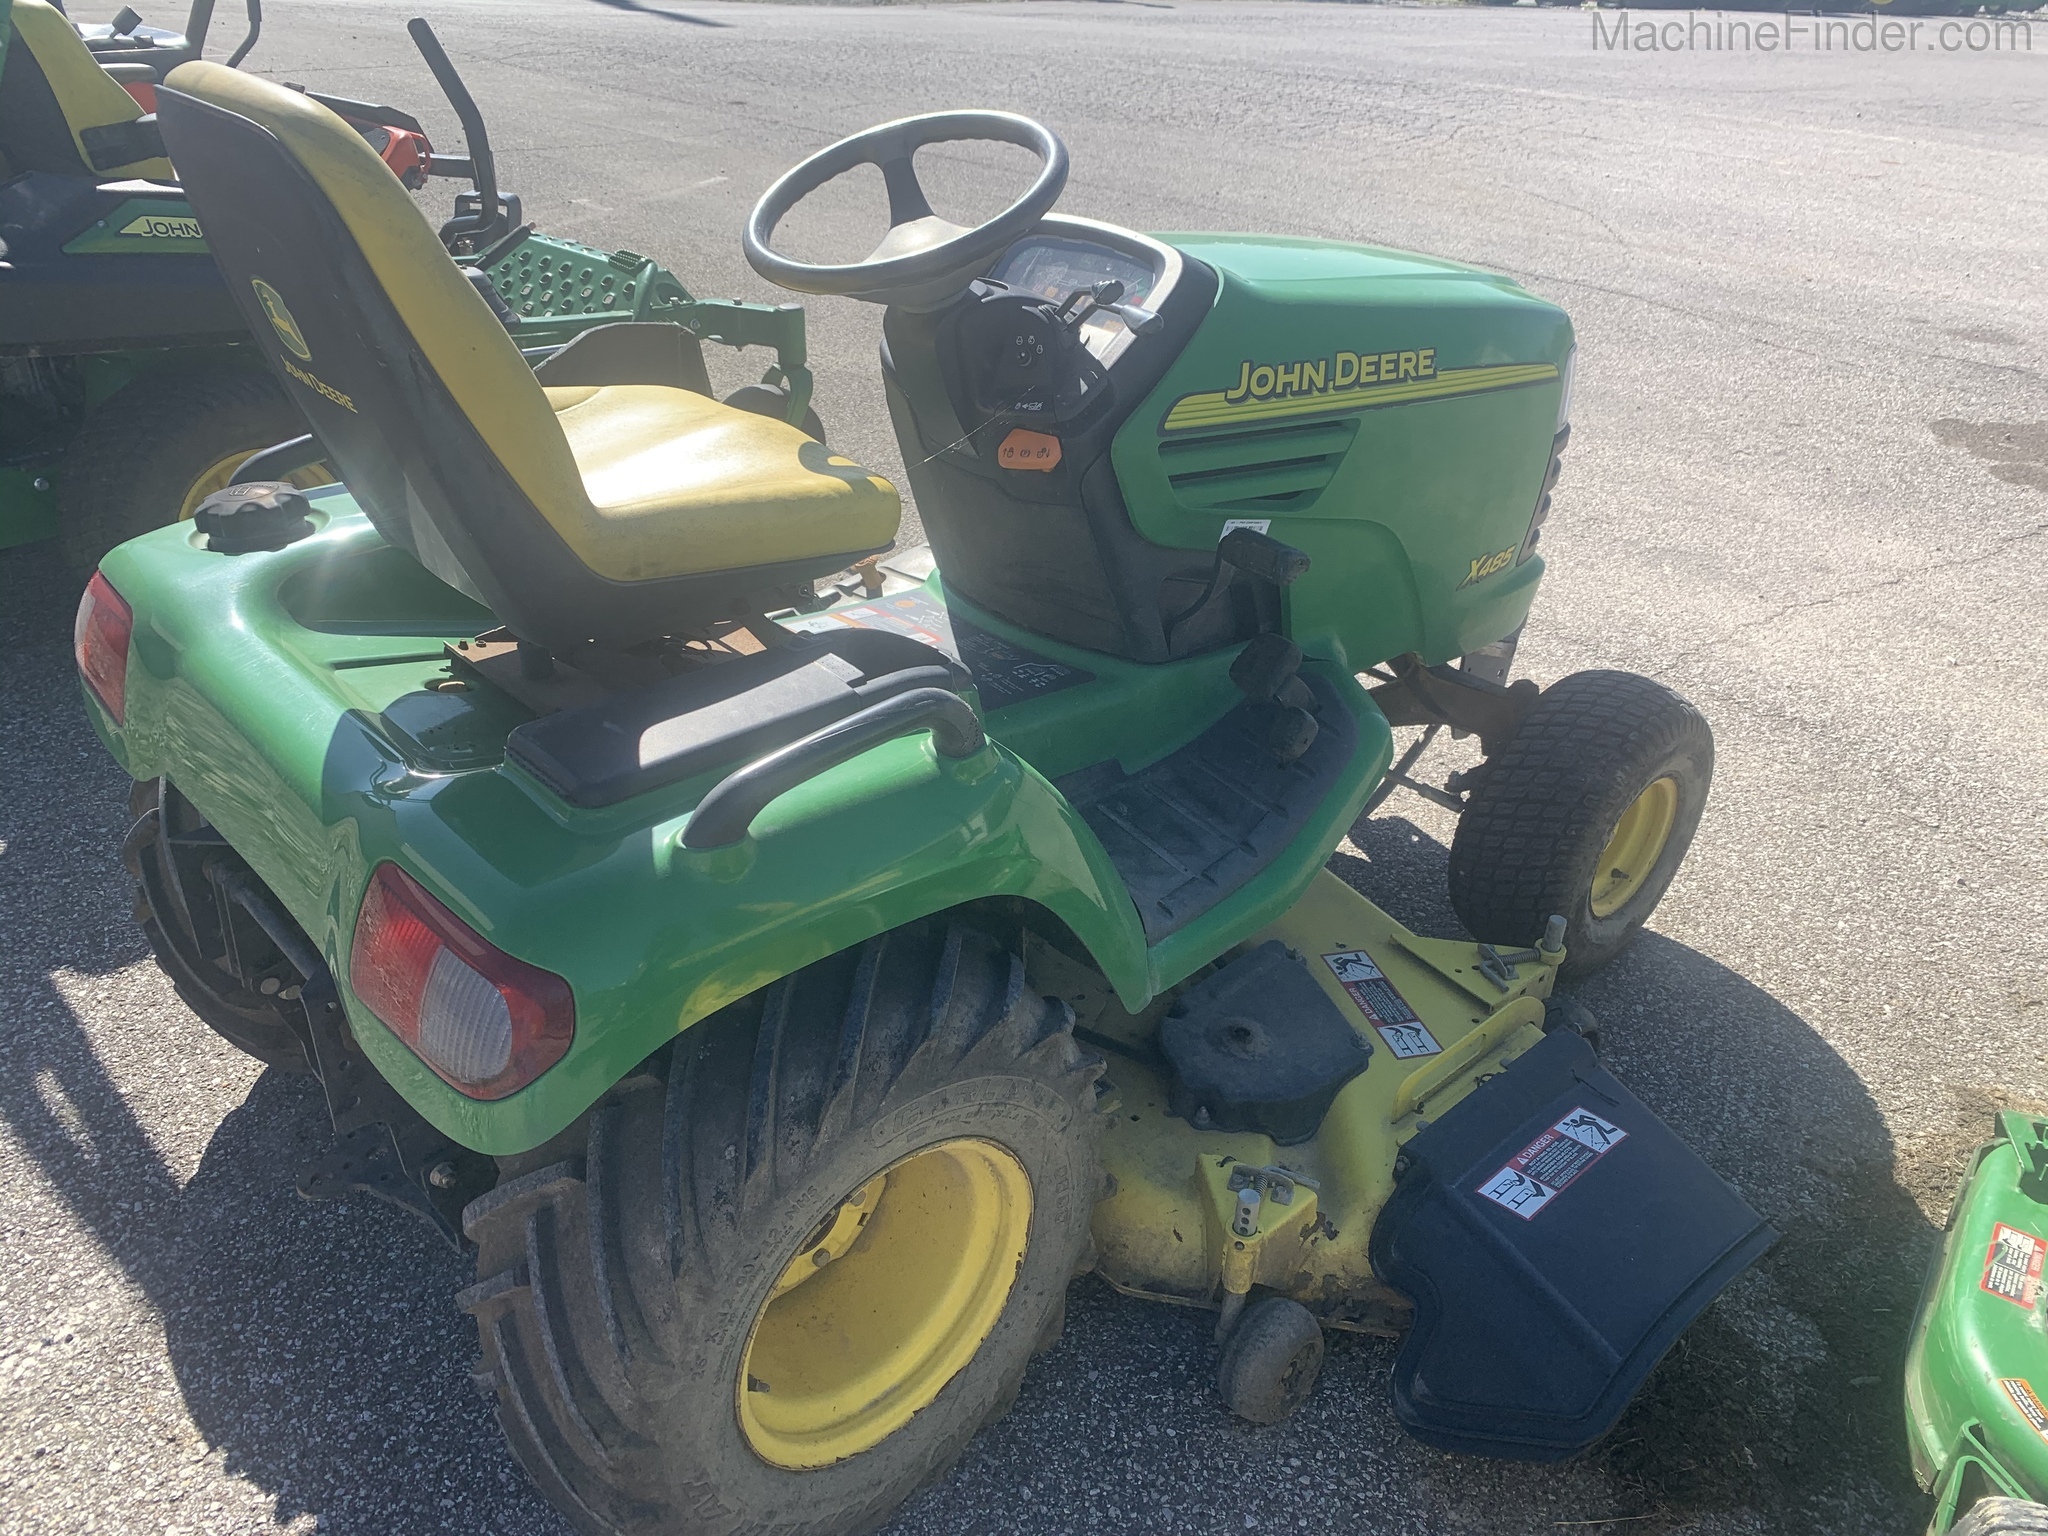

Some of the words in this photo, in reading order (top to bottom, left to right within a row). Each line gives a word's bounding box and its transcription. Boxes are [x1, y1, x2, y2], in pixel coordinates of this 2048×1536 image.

[143, 219, 202, 236] JOHN
[280, 353, 314, 389] JOHN
[307, 372, 358, 414] DEERE
[1226, 360, 1327, 401] JOHN
[1334, 349, 1437, 388] DEERE
[1456, 544, 1516, 590] X485
[1347, 987, 1373, 1013] DANGER
[1521, 1133, 1554, 1158] DANGER
